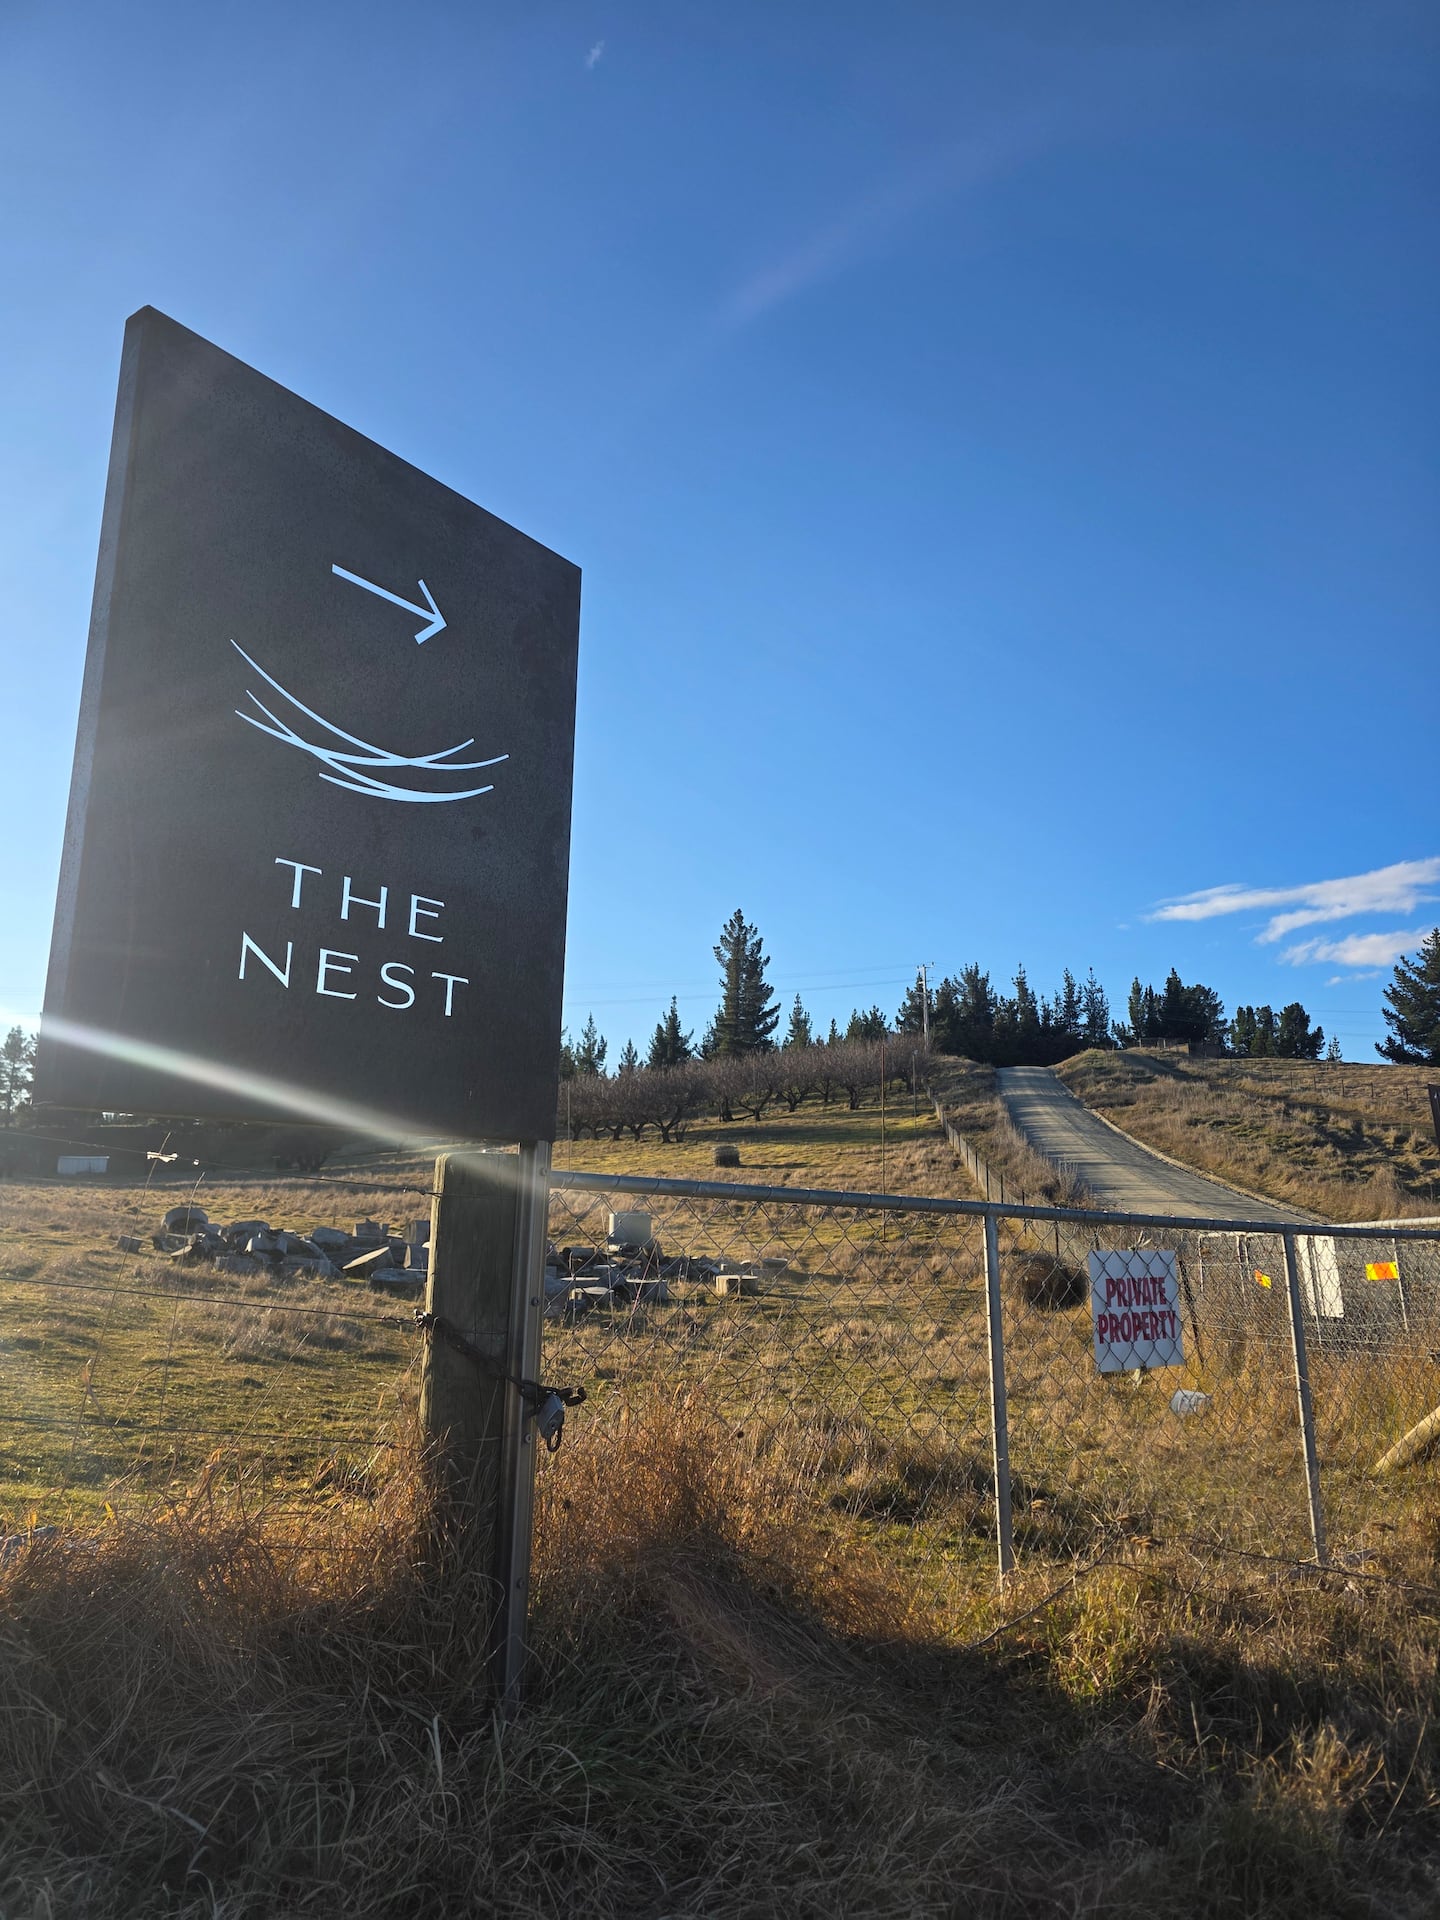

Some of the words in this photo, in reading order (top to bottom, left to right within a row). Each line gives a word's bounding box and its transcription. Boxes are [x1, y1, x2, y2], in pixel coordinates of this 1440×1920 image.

[274, 857, 445, 943] THE
[238, 931, 470, 1017] NEST
[1105, 1276, 1168, 1308] PRIVATE
[1097, 1310, 1177, 1345] PROPERTY
